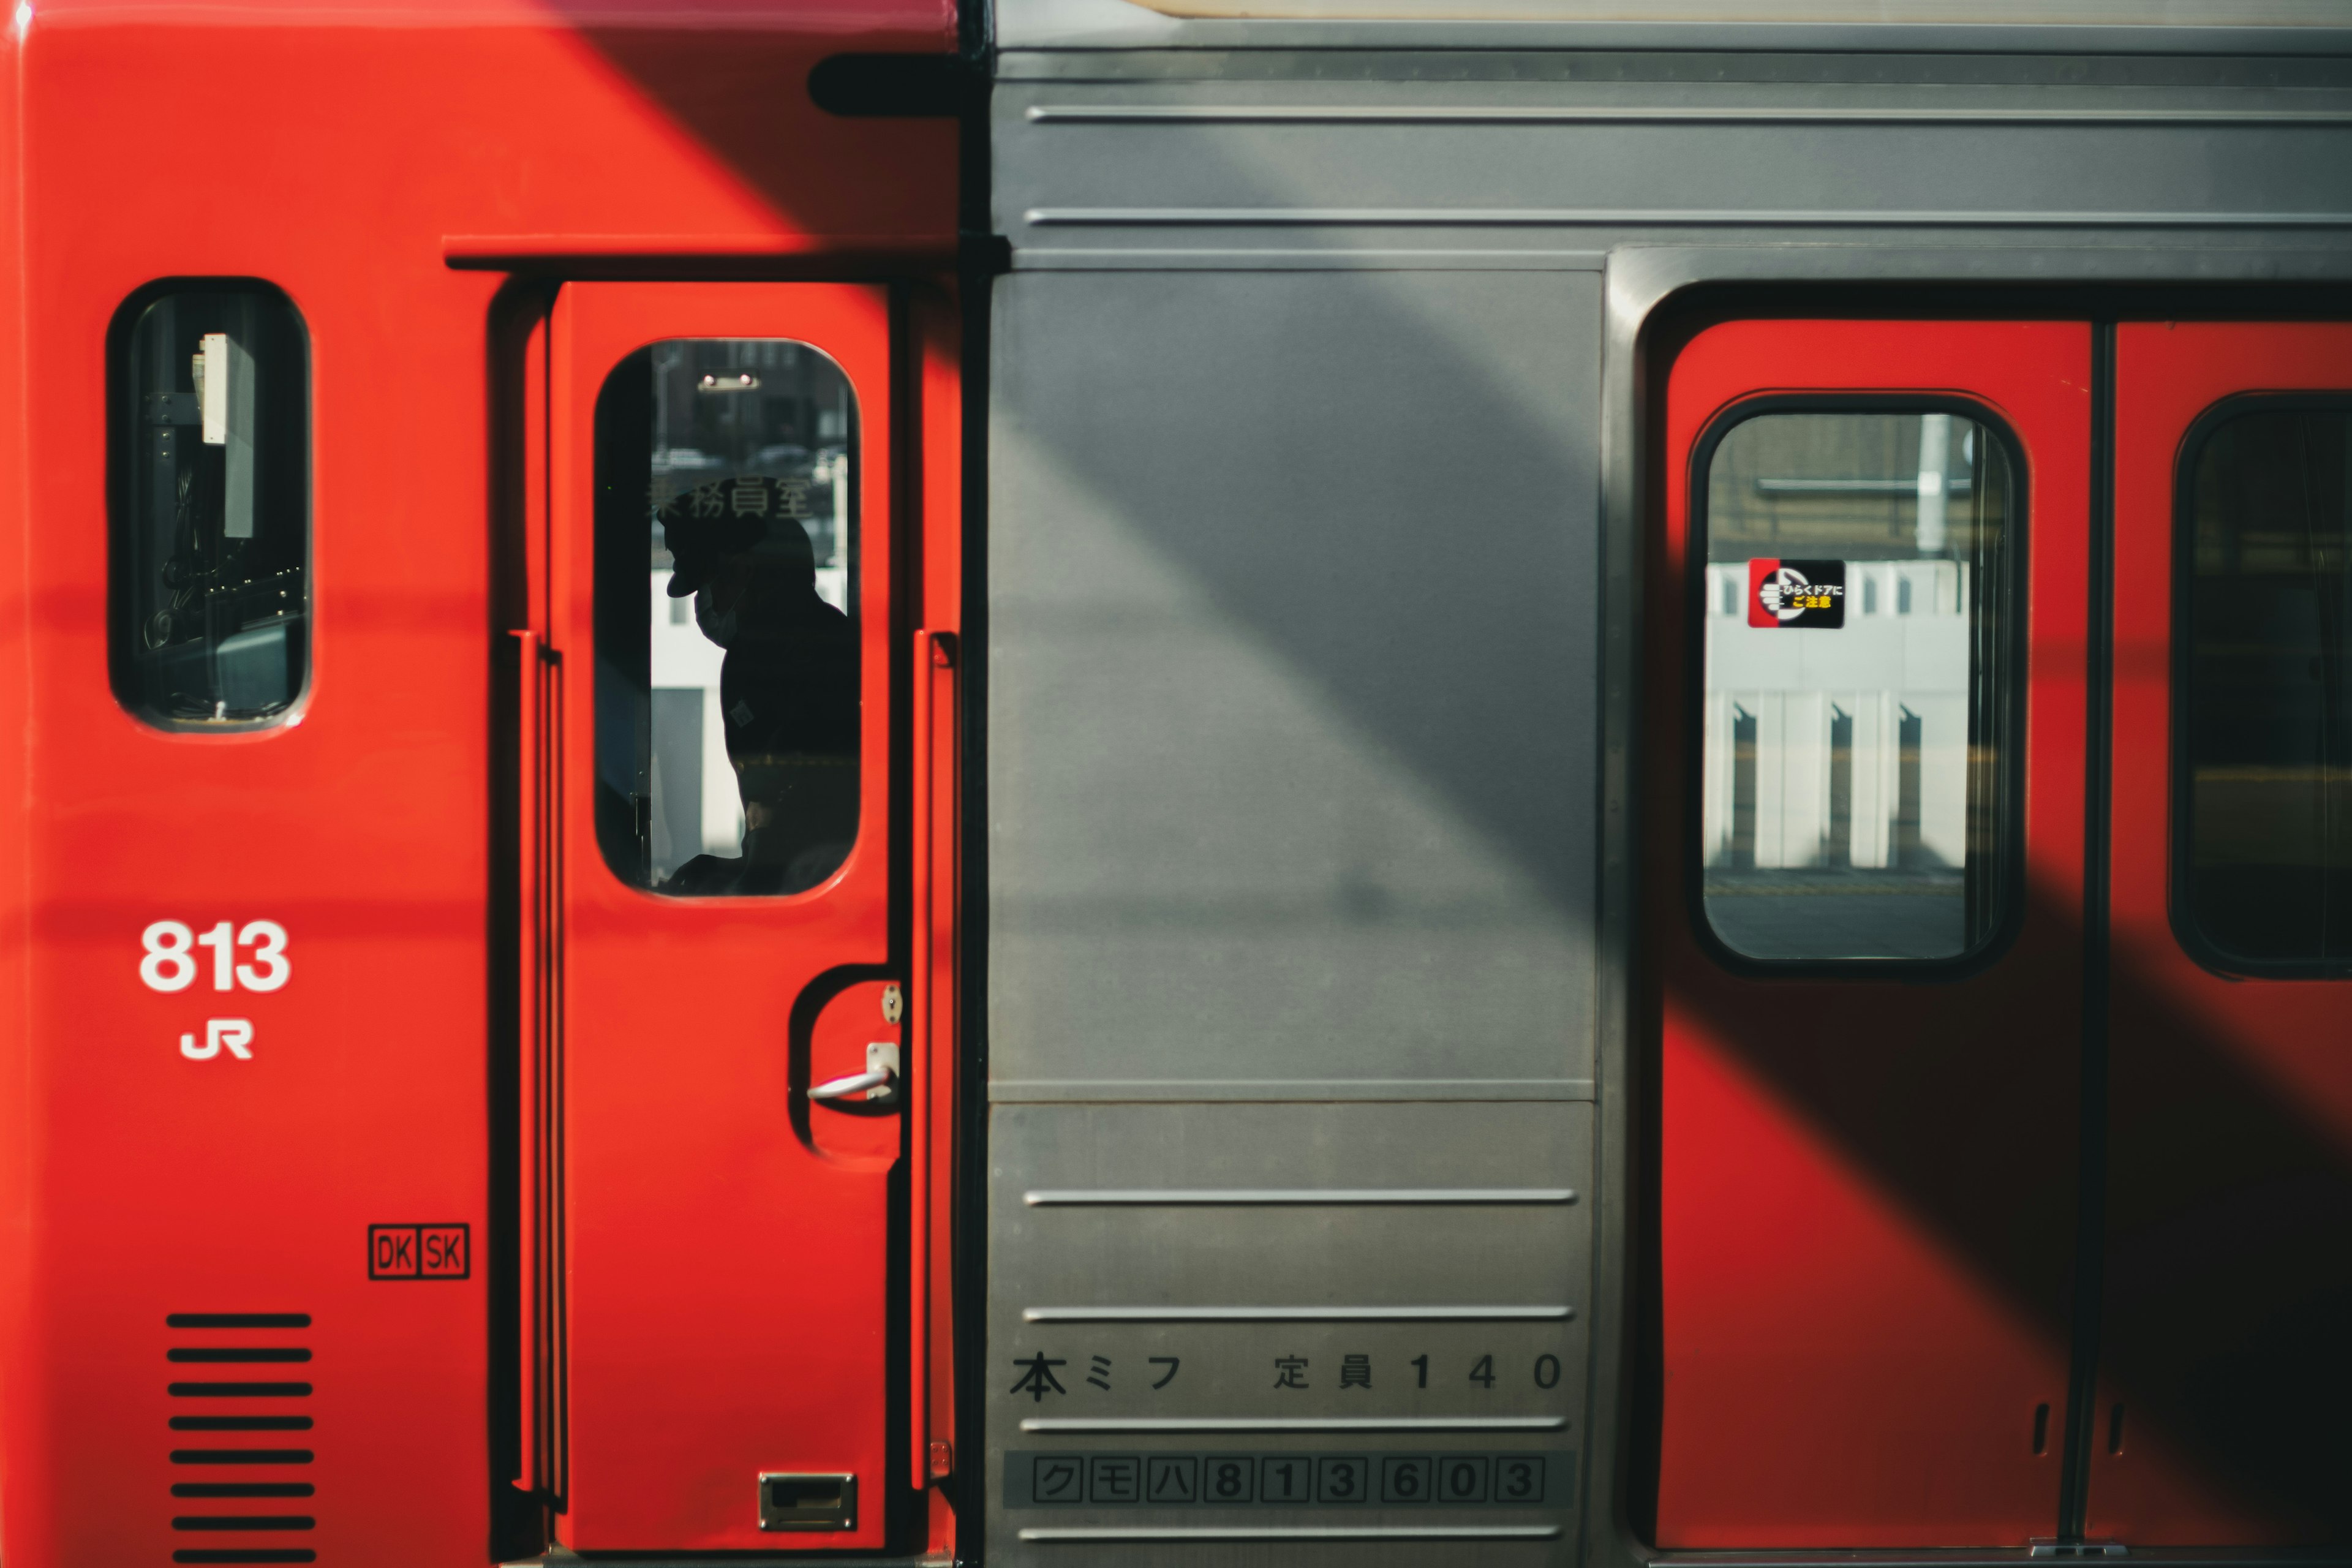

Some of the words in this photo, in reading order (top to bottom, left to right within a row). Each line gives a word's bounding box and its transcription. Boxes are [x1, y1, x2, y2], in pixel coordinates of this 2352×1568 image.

[1783, 585, 1843, 595] ひらくドアに
[1793, 596, 1831, 609] ご注意
[139, 919, 291, 992] 813
[179, 1019, 254, 1060] JR
[378, 1235, 412, 1268] DK
[426, 1235, 460, 1268] SK
